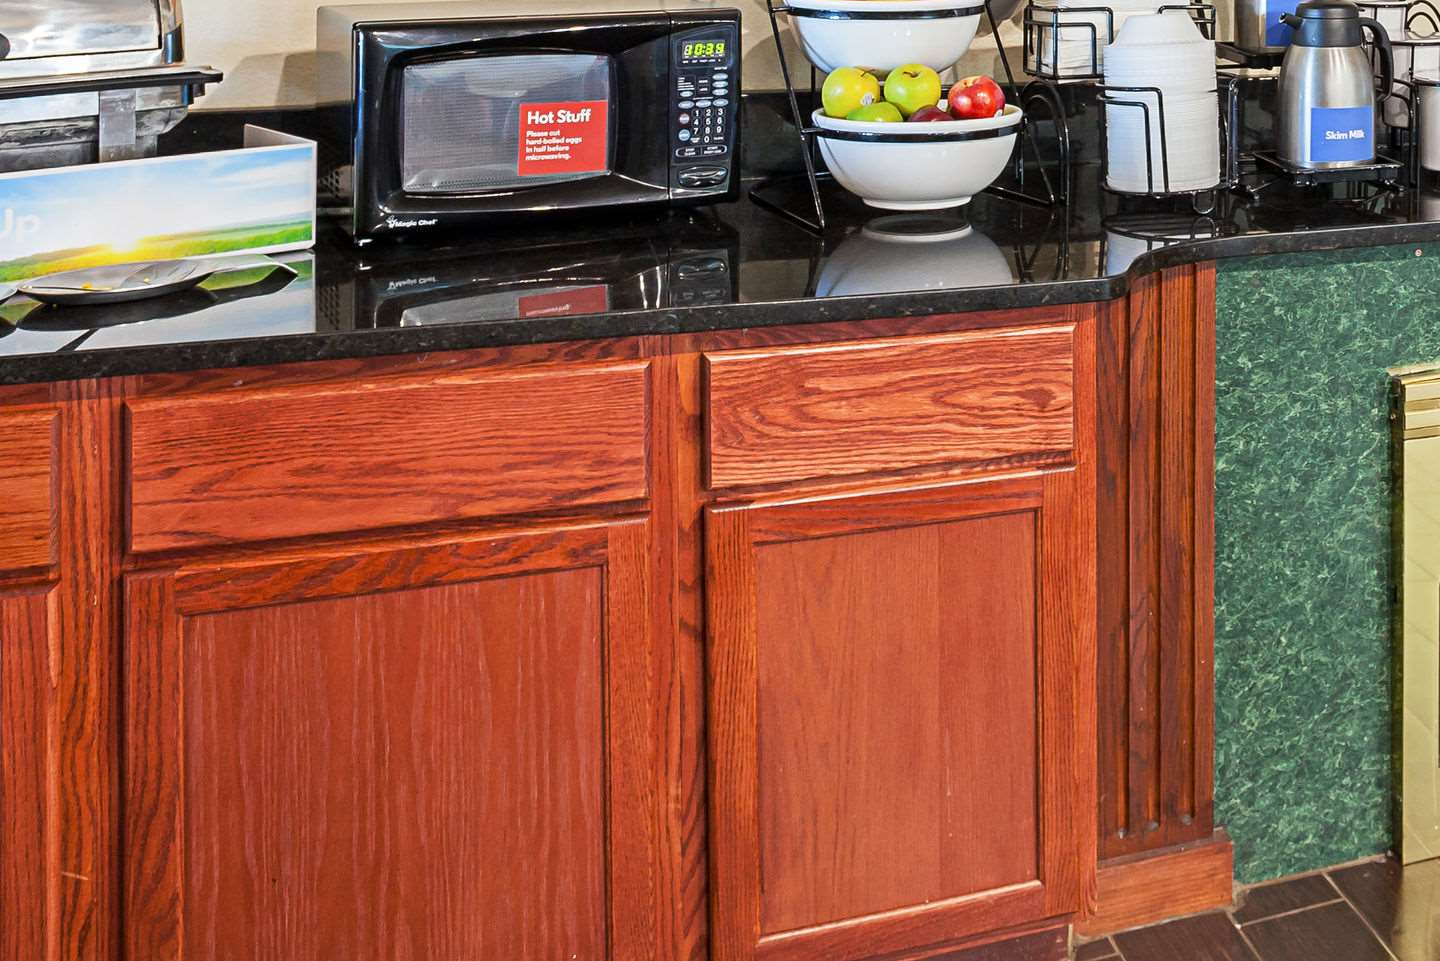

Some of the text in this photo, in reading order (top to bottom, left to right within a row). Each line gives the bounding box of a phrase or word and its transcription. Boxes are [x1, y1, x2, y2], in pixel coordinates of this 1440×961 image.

[527, 108, 592, 125] Hot Stuff
[695, 107, 724, 117] 1 2 3
[693, 118, 699, 126] 4
[716, 116, 723, 125] 6
[693, 125, 722, 135] 7 8 9
[1325, 130, 1348, 140] Skim
[526, 137, 582, 145] hard-boiled eggs
[703, 135, 710, 144] 0
[533, 145, 546, 153] half
[395, 220, 417, 228] Magic
